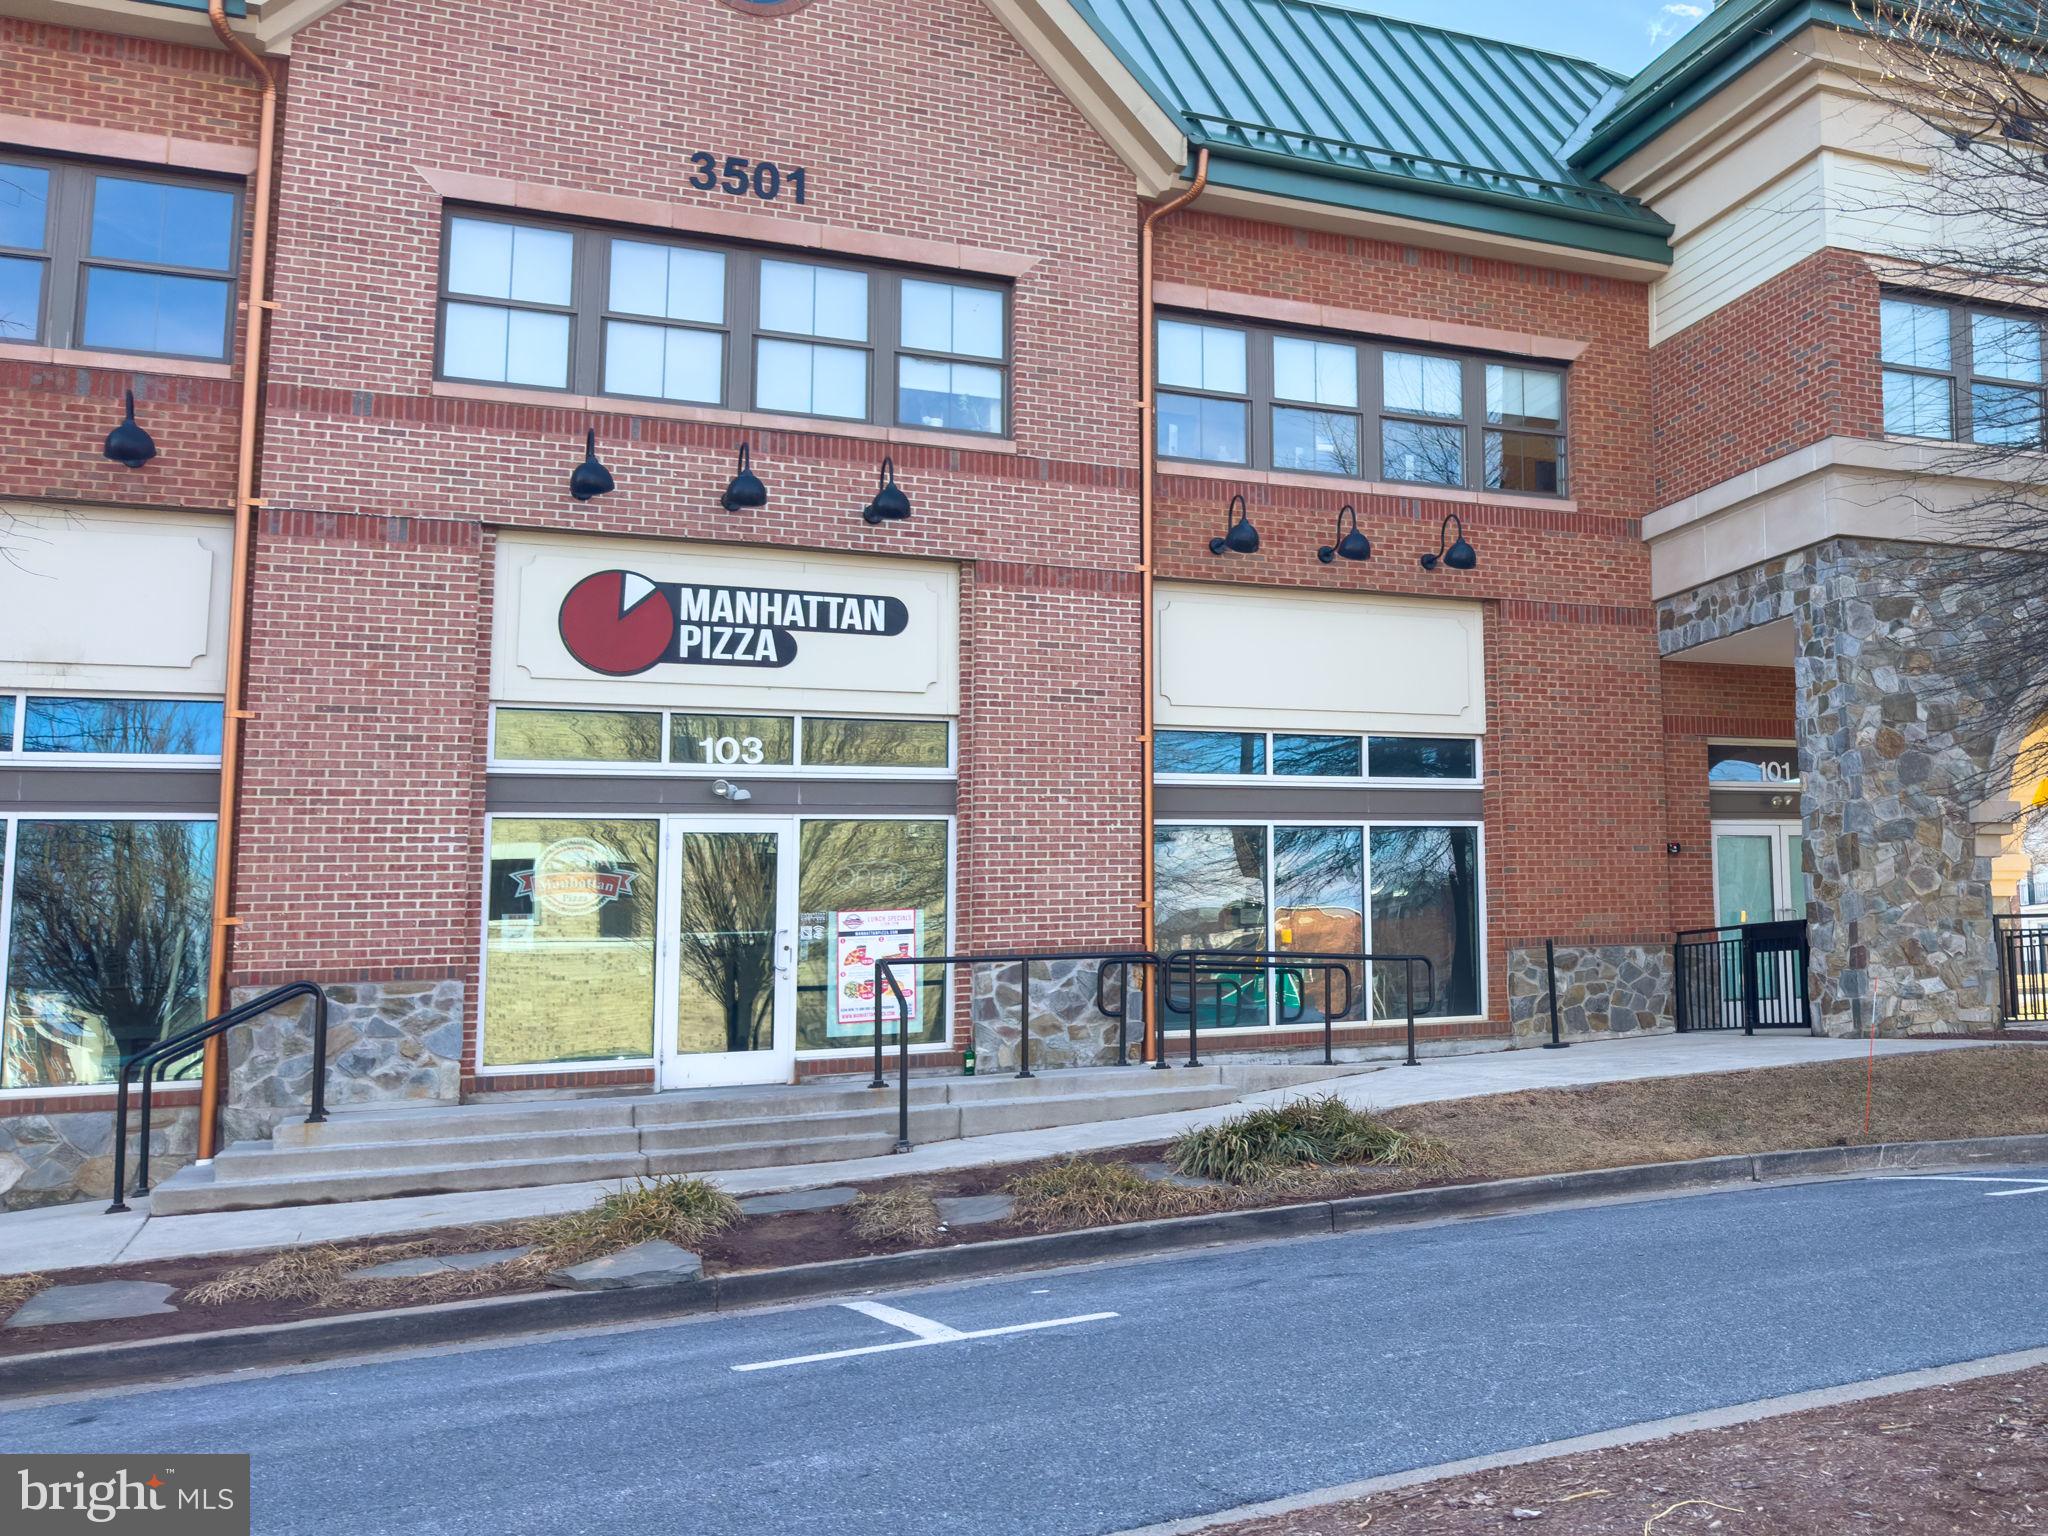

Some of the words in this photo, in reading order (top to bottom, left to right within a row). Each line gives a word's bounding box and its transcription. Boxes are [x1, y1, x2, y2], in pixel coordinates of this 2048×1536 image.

[689, 151, 806, 205] 3501
[680, 587, 886, 631] MANHATTAN
[679, 625, 778, 662] PIZZA
[698, 736, 764, 764] 103
[1759, 761, 1790, 782] 101
